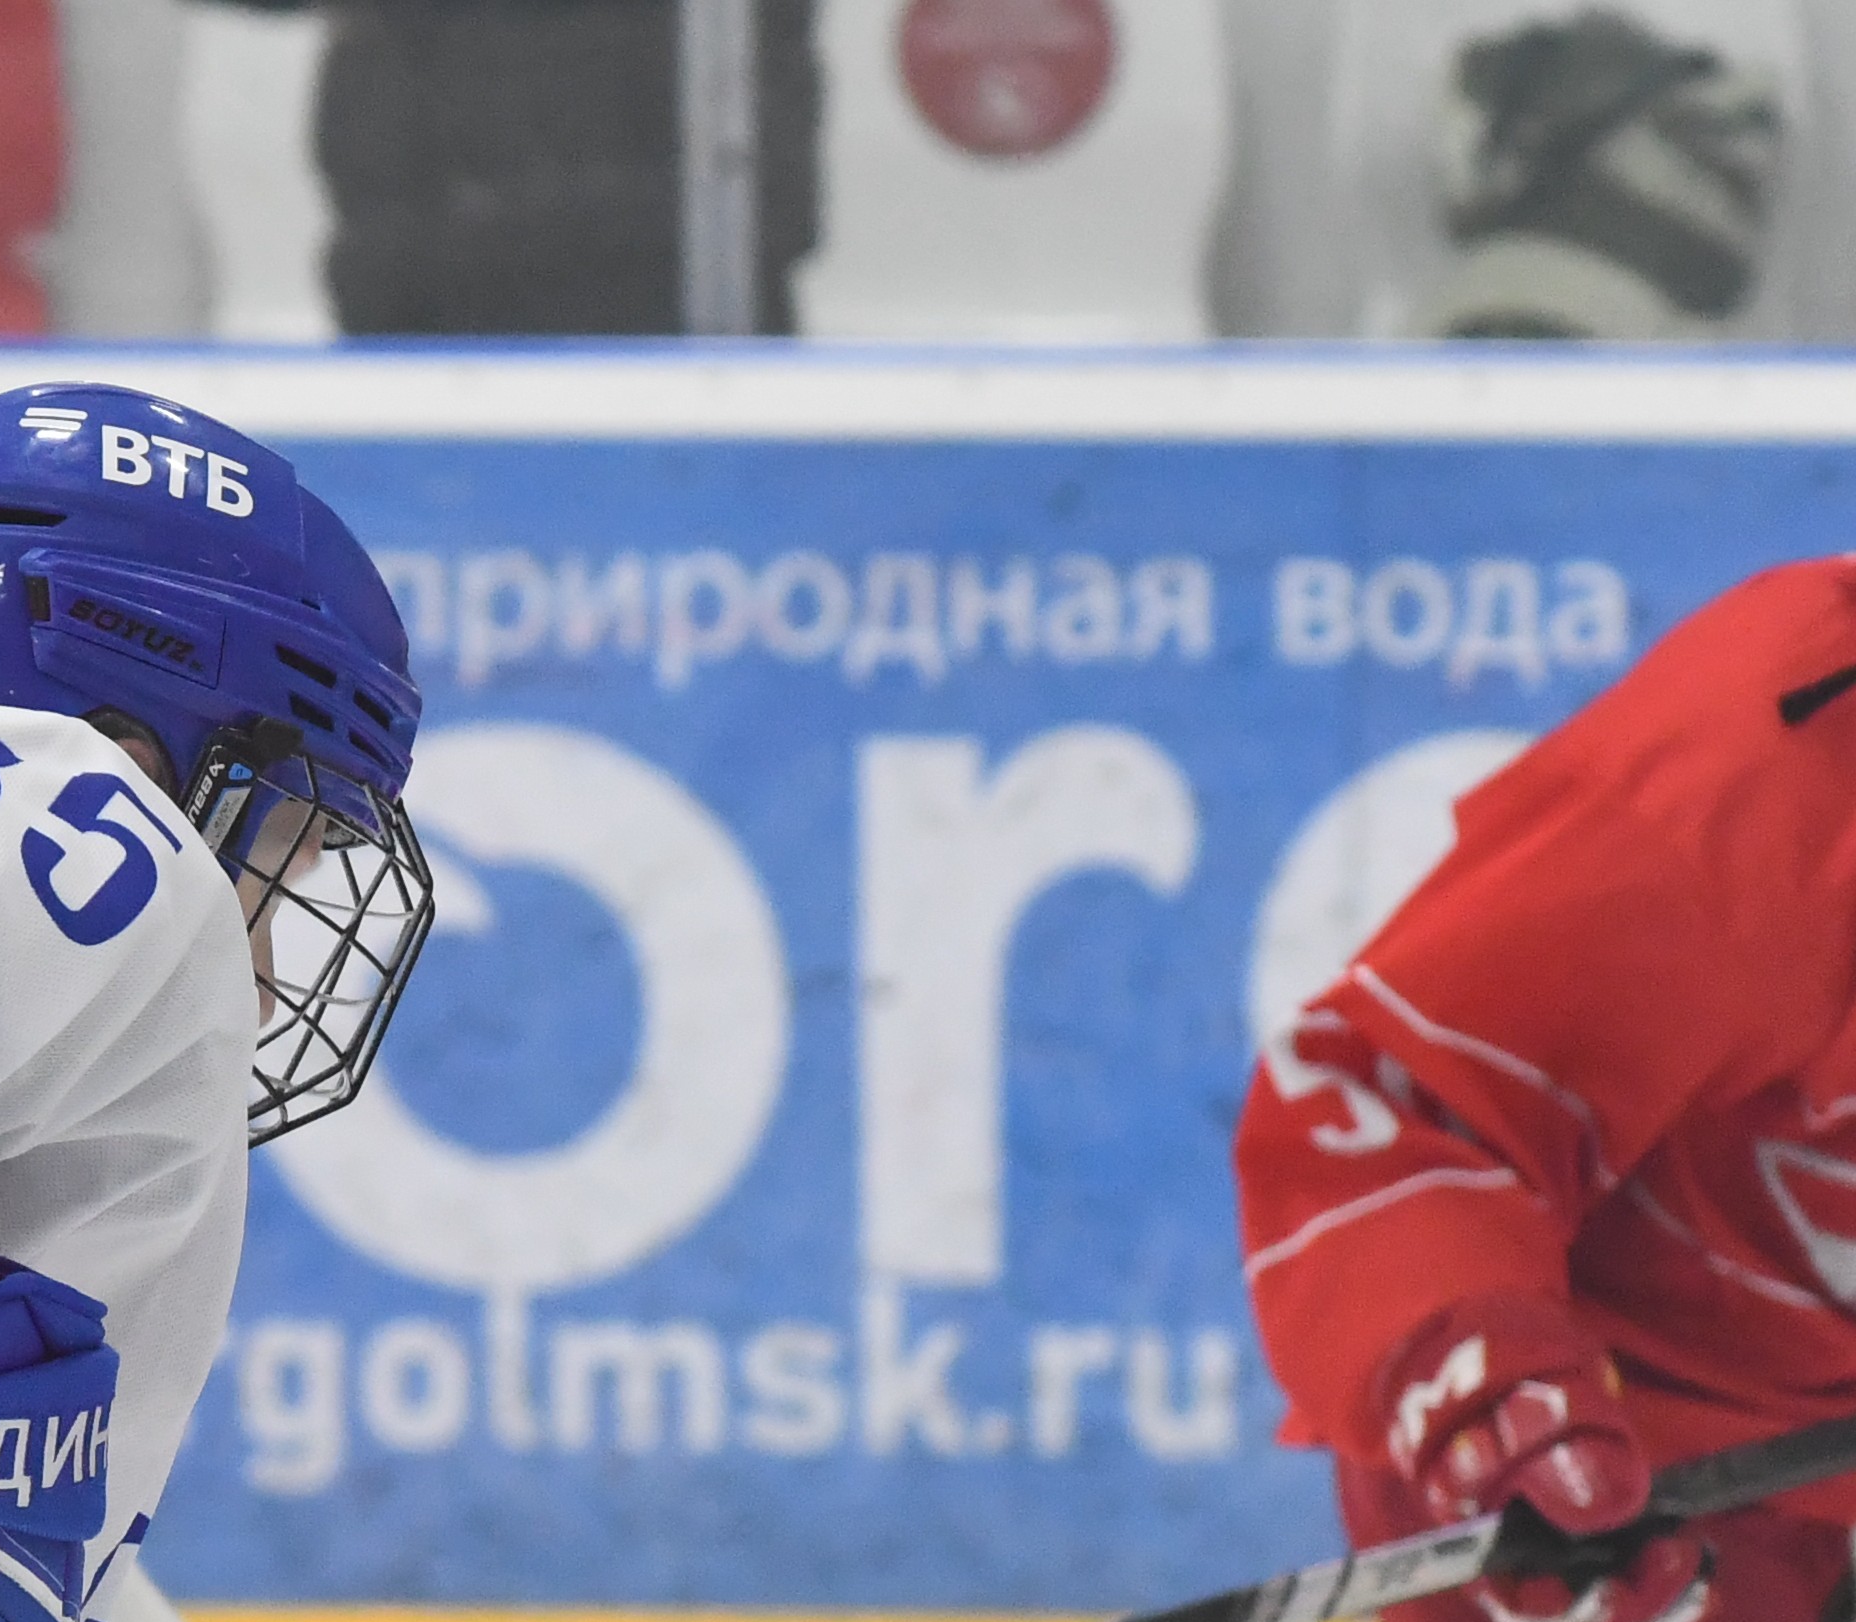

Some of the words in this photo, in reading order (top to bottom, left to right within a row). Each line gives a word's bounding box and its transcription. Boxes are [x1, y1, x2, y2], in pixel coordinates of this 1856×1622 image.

[100, 424, 255, 518] ВТБ
[67, 598, 196, 670] SOYUZ
[381, 545, 1216, 688] природная
[1274, 550, 1632, 688] вода
[212, 1280, 1240, 1497] golmsk.ru
